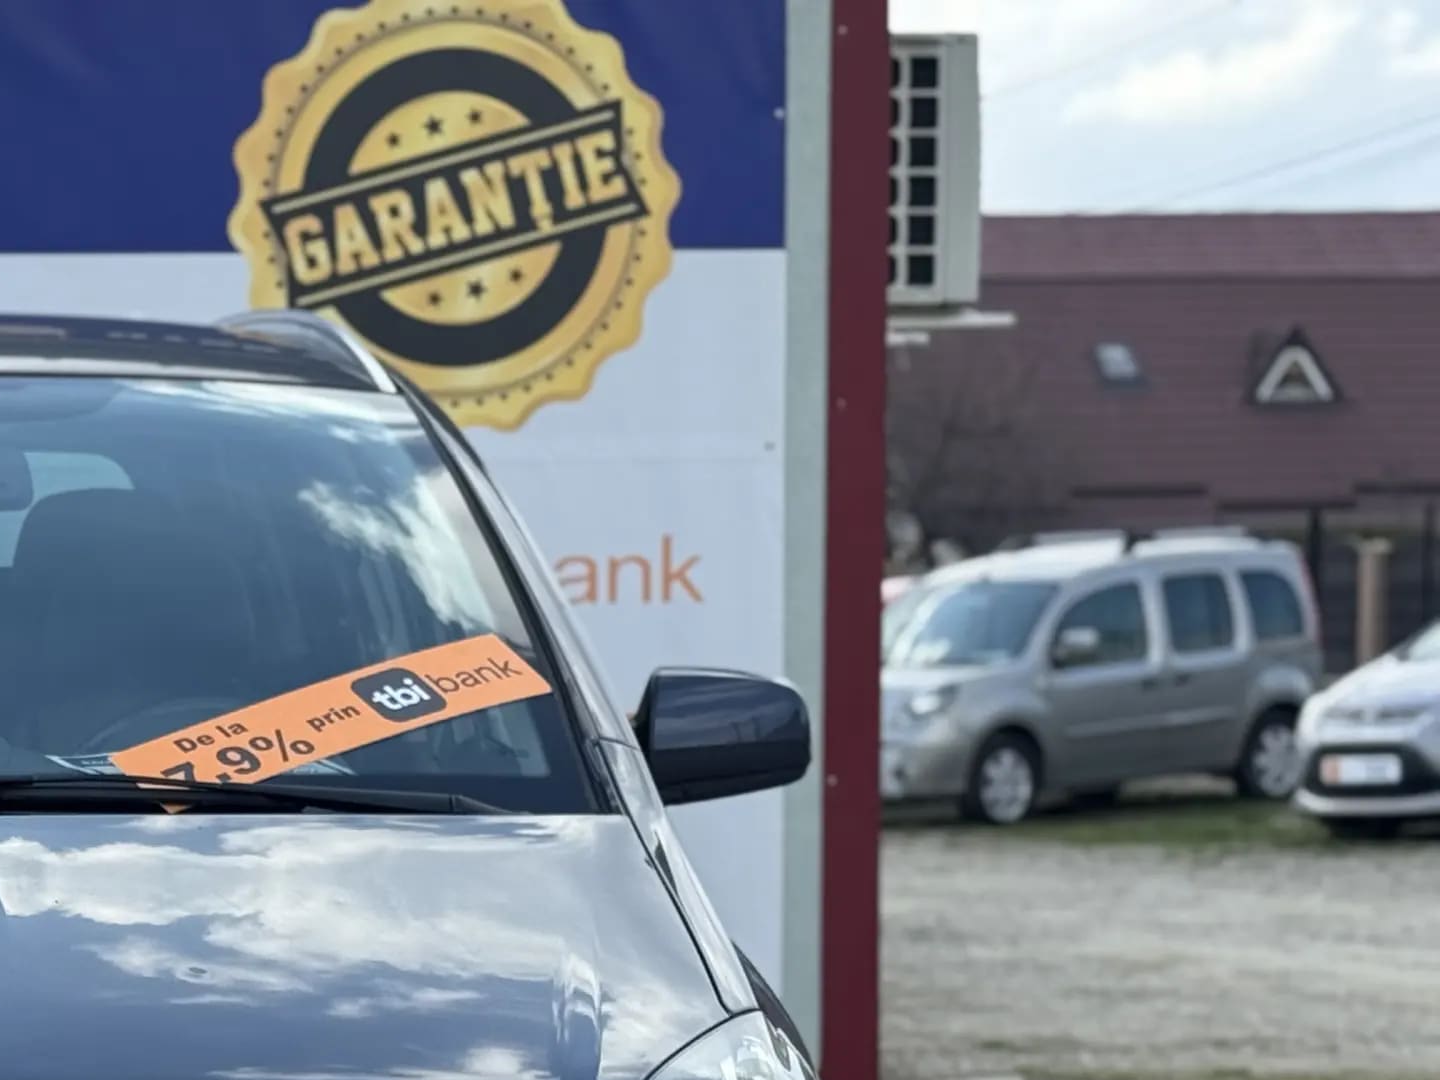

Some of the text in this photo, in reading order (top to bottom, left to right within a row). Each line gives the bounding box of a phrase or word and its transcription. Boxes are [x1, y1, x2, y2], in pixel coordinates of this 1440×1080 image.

[554, 532, 704, 606] ank
[306, 703, 361, 732] prin
[371, 677, 432, 711] tbi
[424, 656, 523, 695] bank
[173, 721, 249, 754] De la
